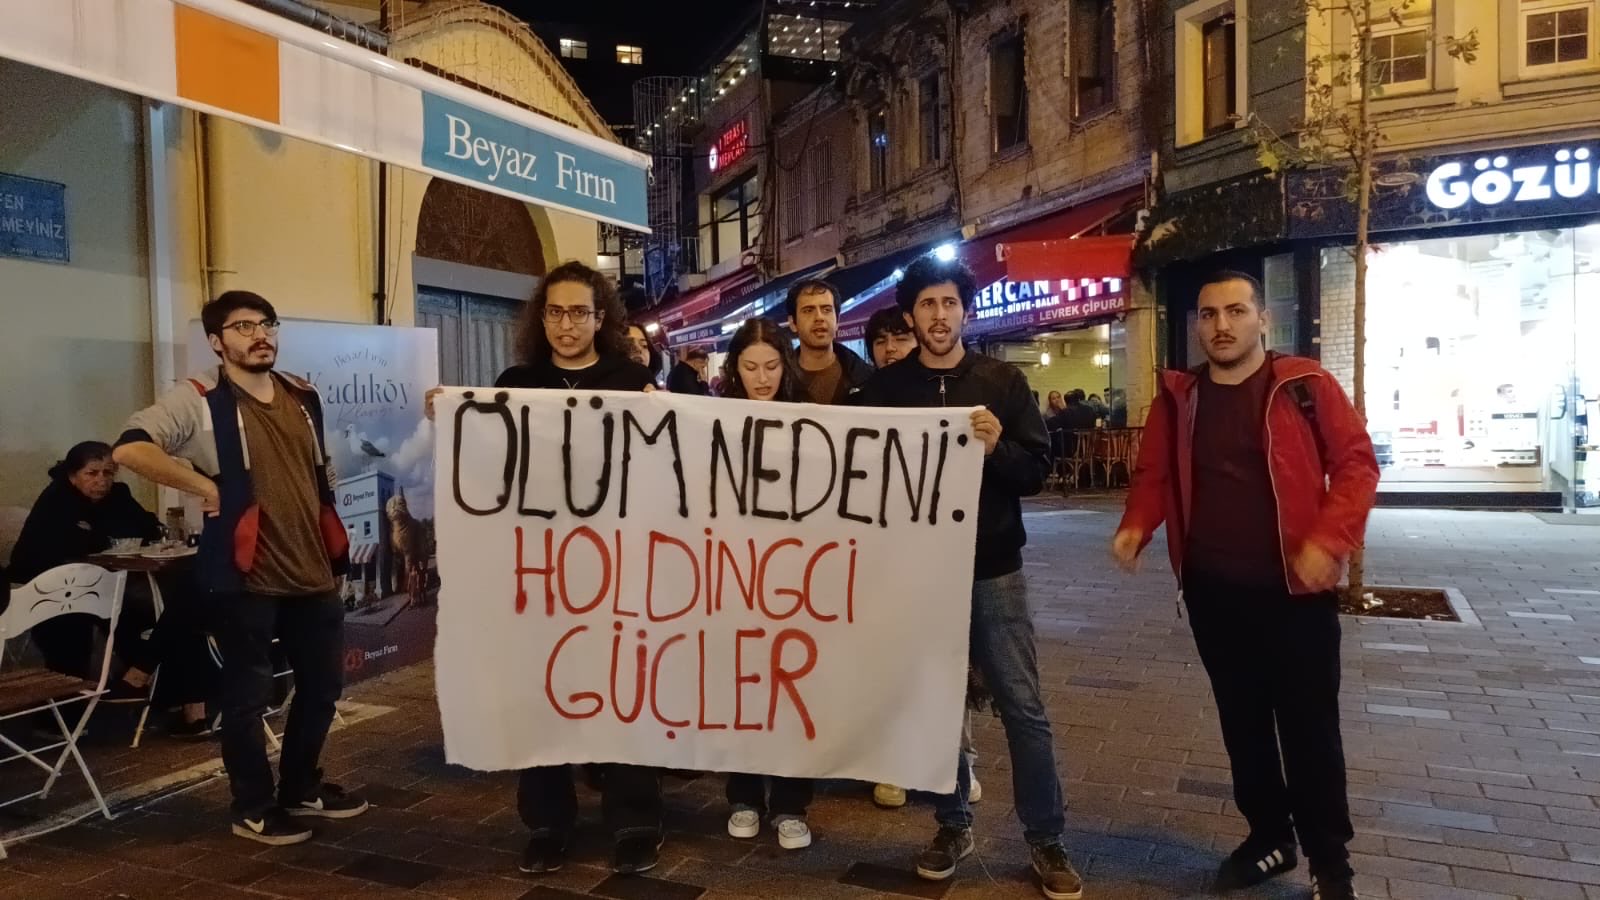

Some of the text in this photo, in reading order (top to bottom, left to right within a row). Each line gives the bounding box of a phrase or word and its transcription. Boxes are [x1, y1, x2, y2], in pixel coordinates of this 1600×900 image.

[445, 113, 616, 204] Beyaz Fırın
[1426, 147, 1600, 209] GÖZÜ
[0, 217, 64, 239] MEYİNİZ
[1039, 304, 1080, 321] LEVREK
[1082, 297, 1125, 316] ÇİPURA
[453, 390, 968, 527] ÖLÜM NEDENİ:
[514, 525, 857, 623] HOLDİNGCİ
[545, 621, 818, 740] GÜÇLER
